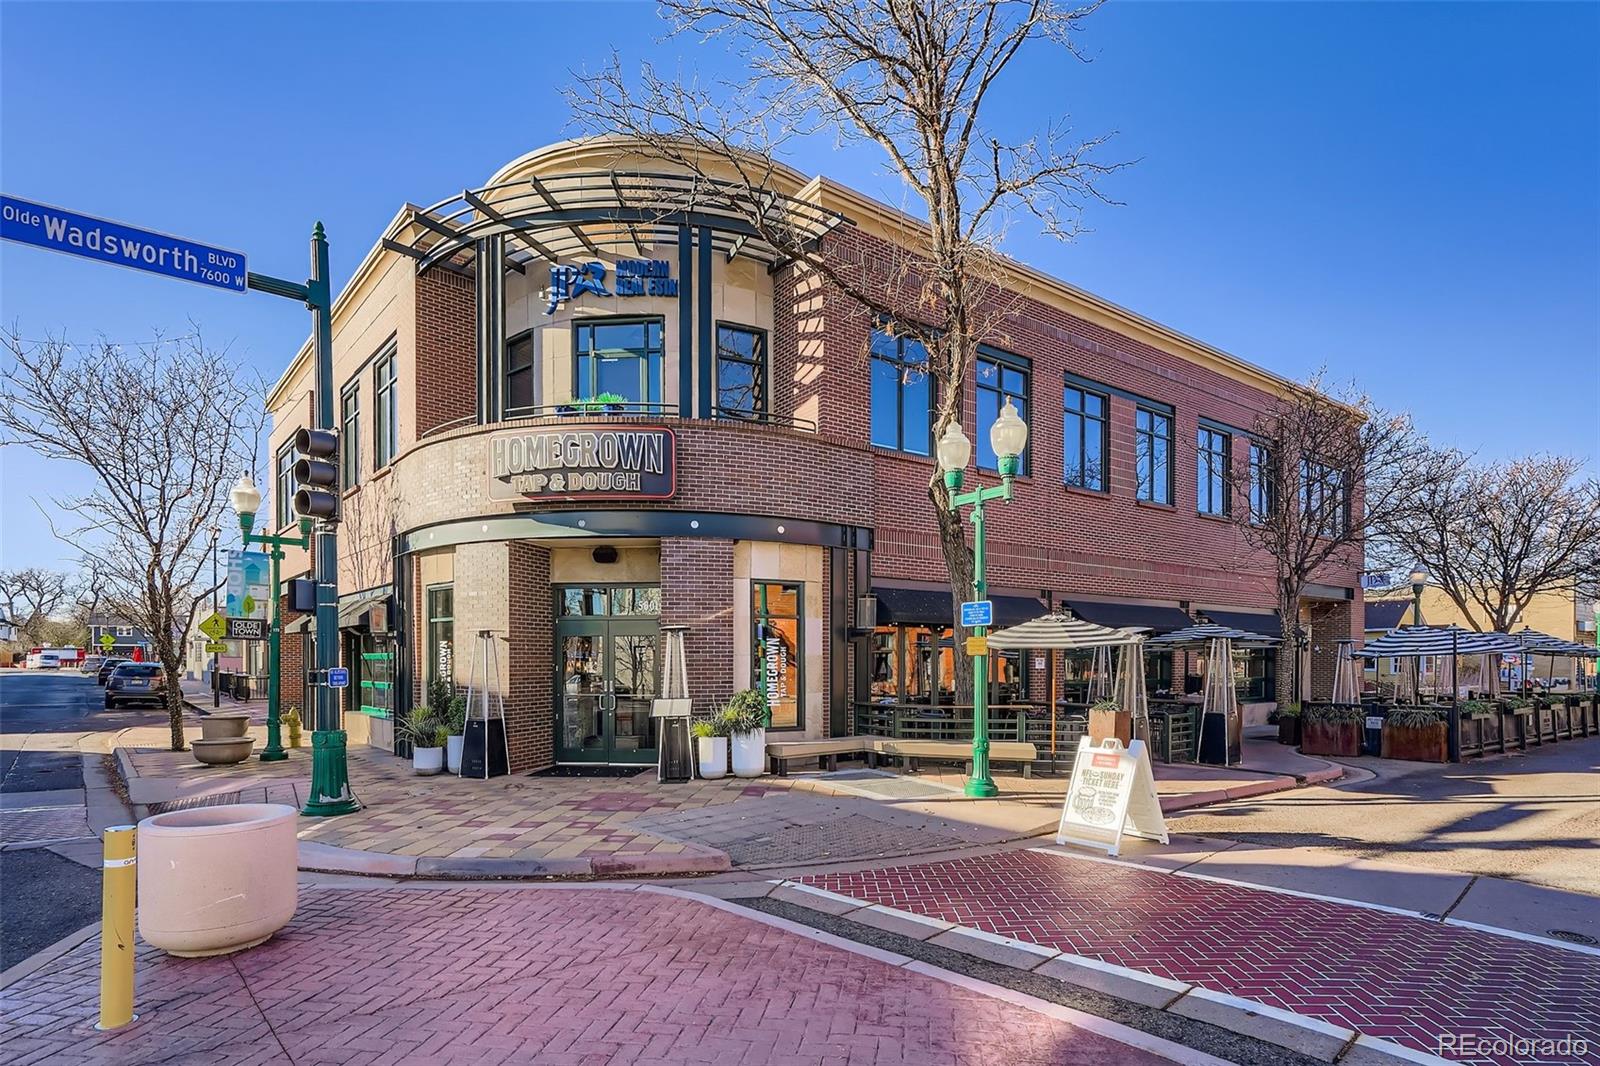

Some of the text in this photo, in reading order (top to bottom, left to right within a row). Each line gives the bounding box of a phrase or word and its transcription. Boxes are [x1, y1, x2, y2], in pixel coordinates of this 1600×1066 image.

[2, 206, 237, 274] Olde Wadsworth BLVD
[200, 267, 244, 287] 7600 W
[615, 260, 669, 278] MODERN
[615, 276, 678, 297] REAL ESTA
[491, 432, 664, 478] HOMEGROWN
[511, 472, 641, 493] TAP & DOUGH
[235, 621, 258, 629] OLDE
[766, 637, 780, 706] HOMEGROWN
